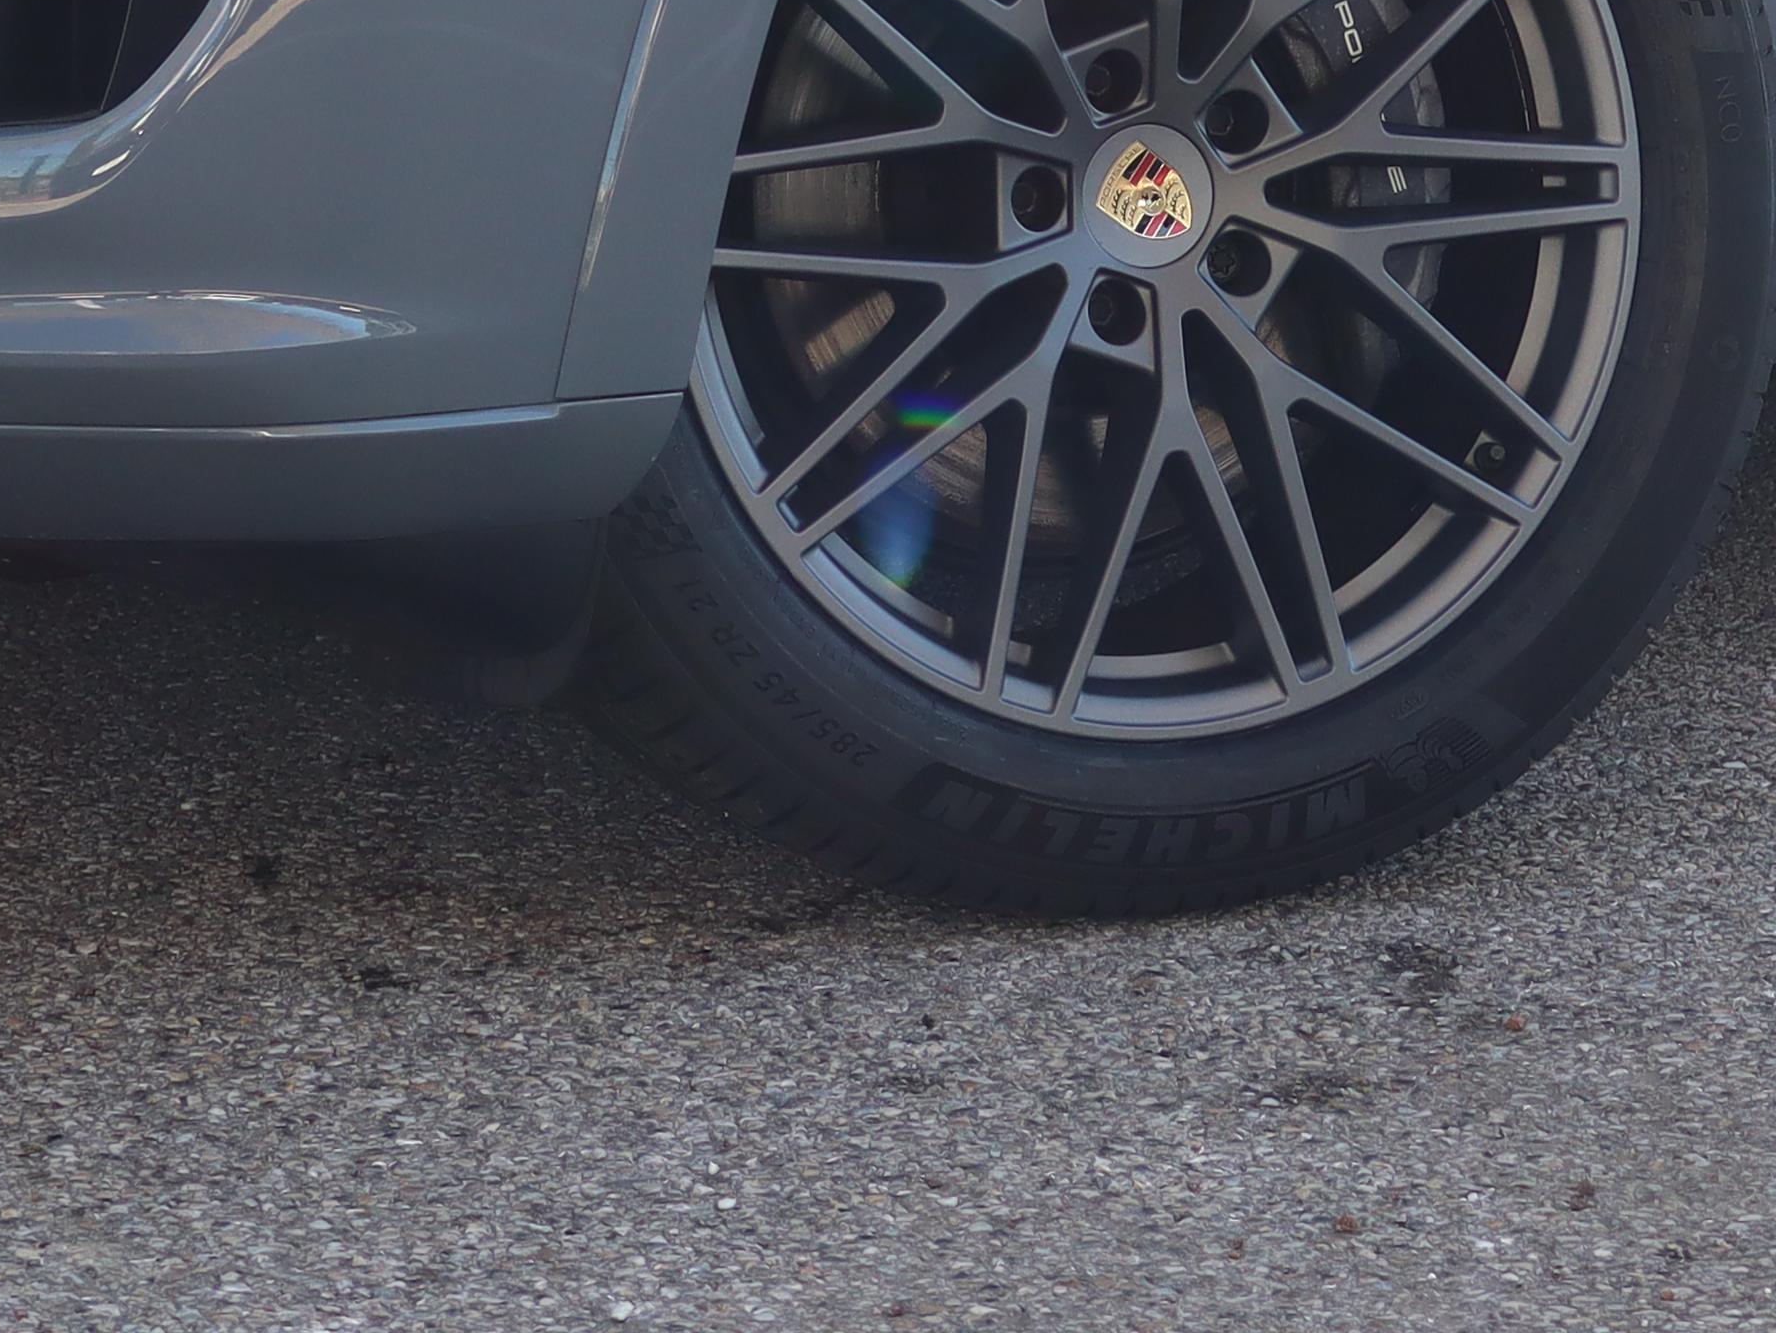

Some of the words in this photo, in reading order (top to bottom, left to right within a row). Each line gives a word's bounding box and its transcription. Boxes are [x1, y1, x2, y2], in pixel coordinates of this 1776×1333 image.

[710, 622, 760, 668] ZR
[753, 670, 880, 767] 285/45
[924, 773, 1367, 868] MICHELIN
